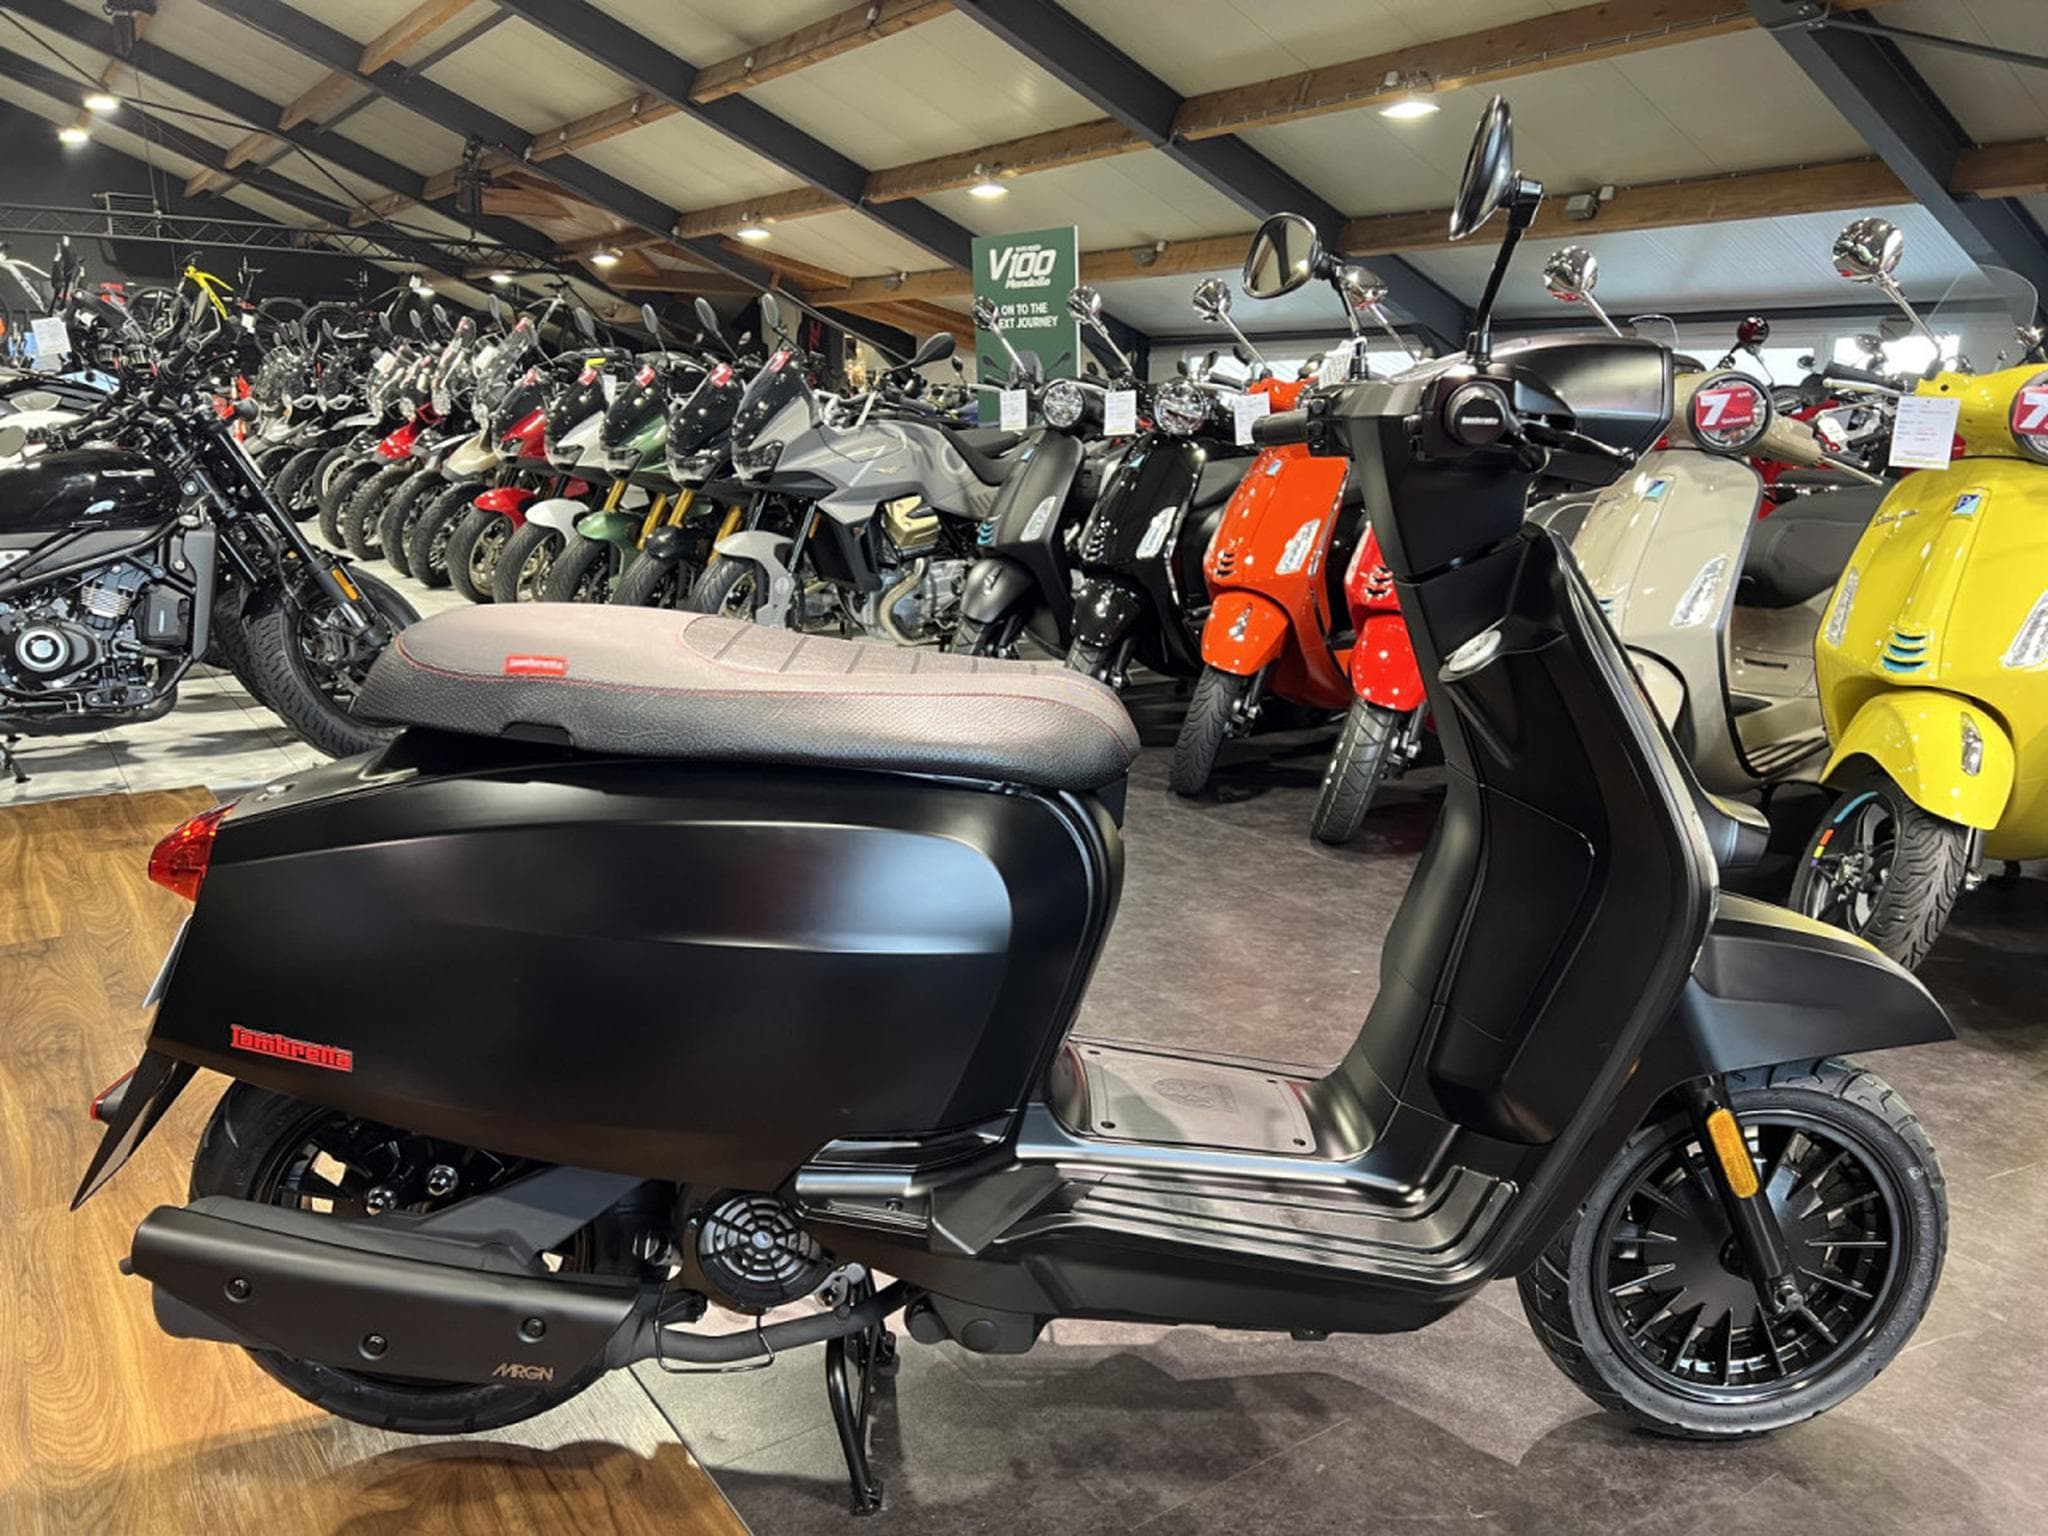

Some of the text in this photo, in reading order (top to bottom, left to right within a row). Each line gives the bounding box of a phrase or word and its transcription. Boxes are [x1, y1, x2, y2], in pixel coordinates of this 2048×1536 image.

[989, 246, 1056, 280] V100
[998, 316, 1058, 329] EXT JOURNEY
[1001, 302, 1048, 315] ON TO THE
[1700, 393, 1732, 427] 7
[2019, 391, 2048, 429] 7
